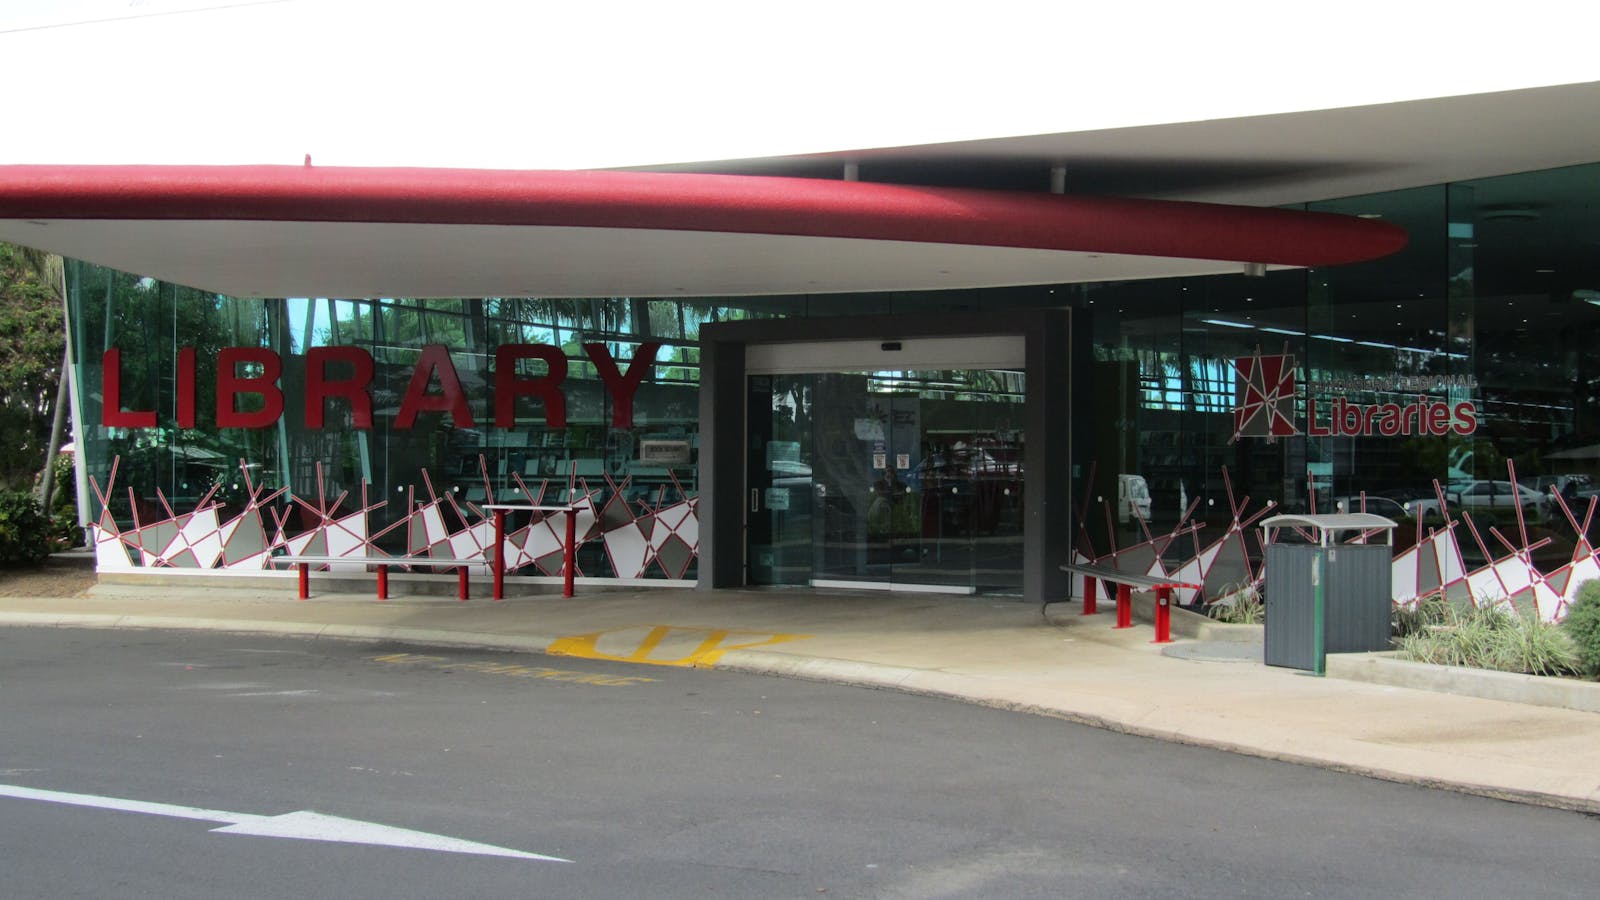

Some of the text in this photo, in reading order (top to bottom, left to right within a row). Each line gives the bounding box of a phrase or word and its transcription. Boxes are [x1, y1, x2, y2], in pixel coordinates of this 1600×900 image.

[102, 343, 662, 429] LIBRARY
[1399, 373, 1478, 391] REGIONAL
[1308, 395, 1477, 437] Libraries
